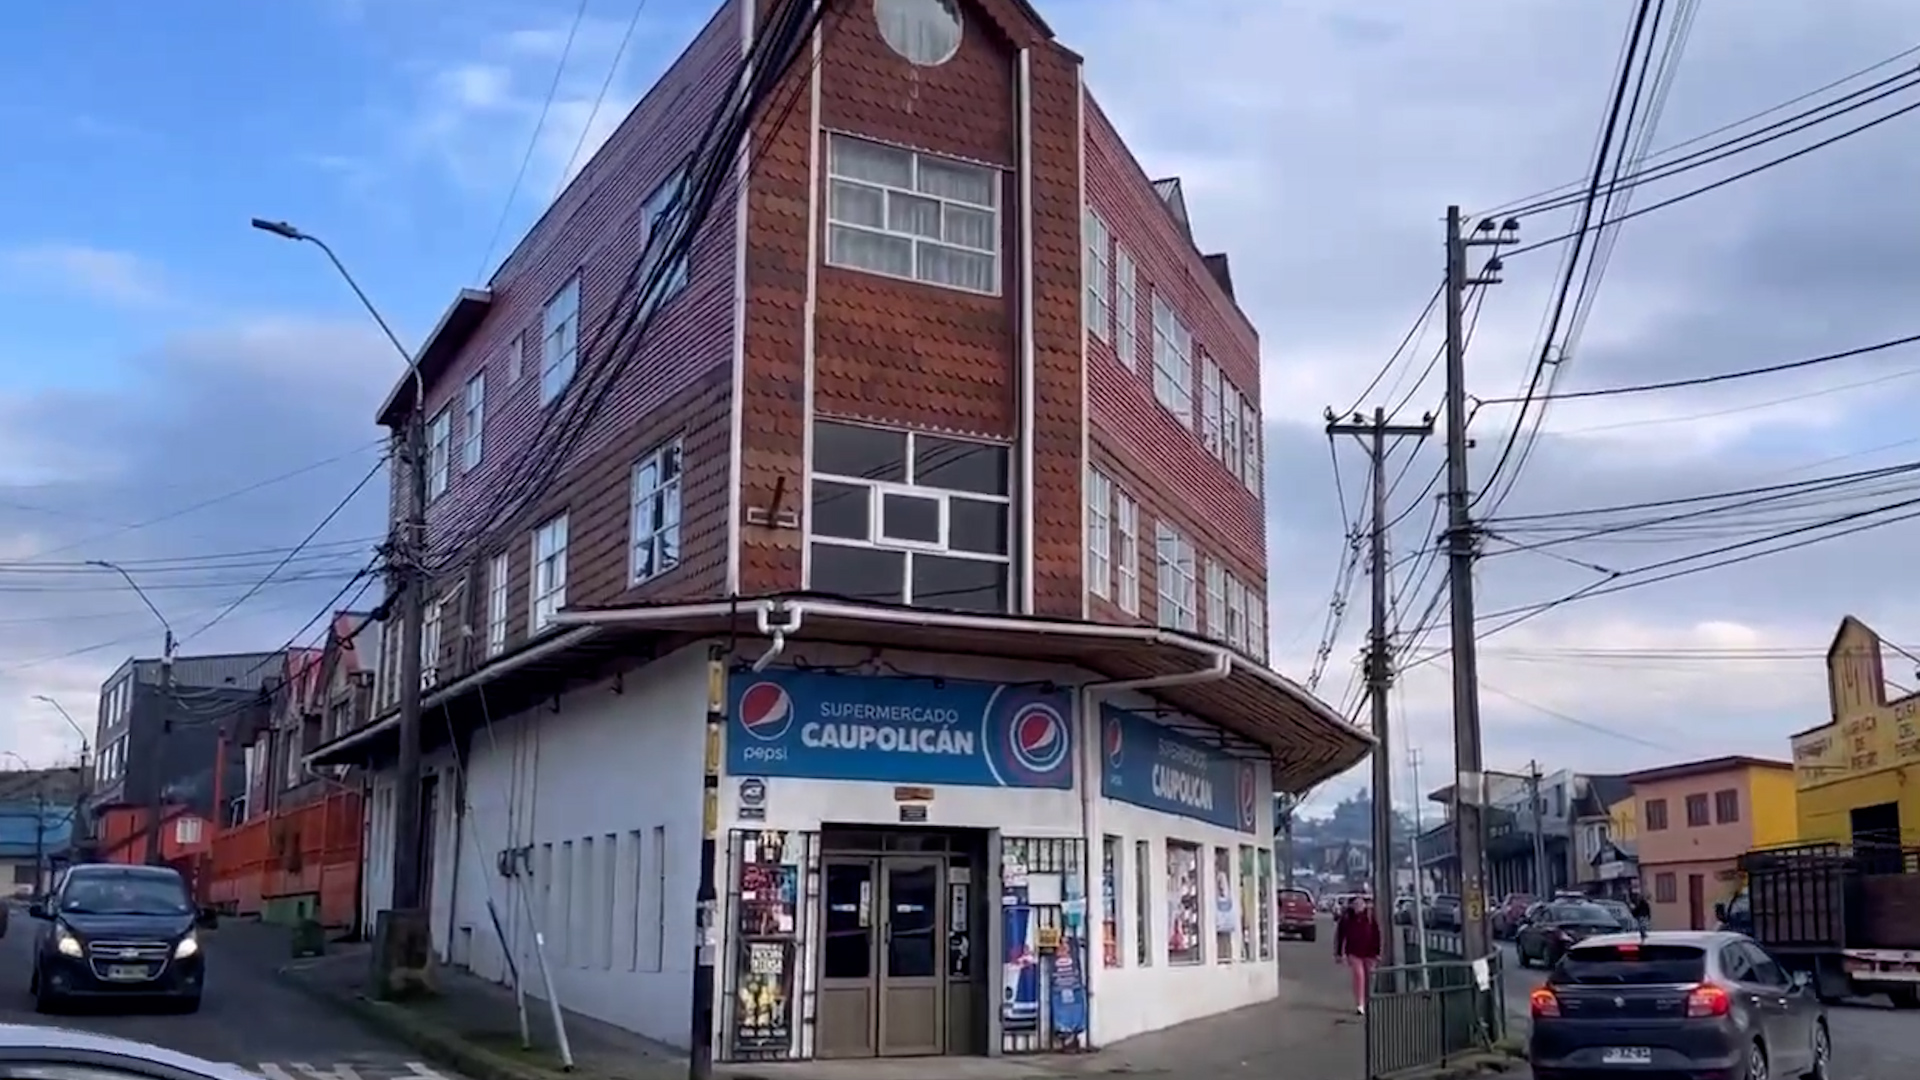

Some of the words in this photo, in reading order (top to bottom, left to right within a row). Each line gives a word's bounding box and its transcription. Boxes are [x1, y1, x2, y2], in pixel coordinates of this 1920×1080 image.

[820, 701, 959, 725] SUPERMERCADO
[801, 721, 974, 755] CAUPOLICÁN
[744, 746, 788, 762] pepsi
